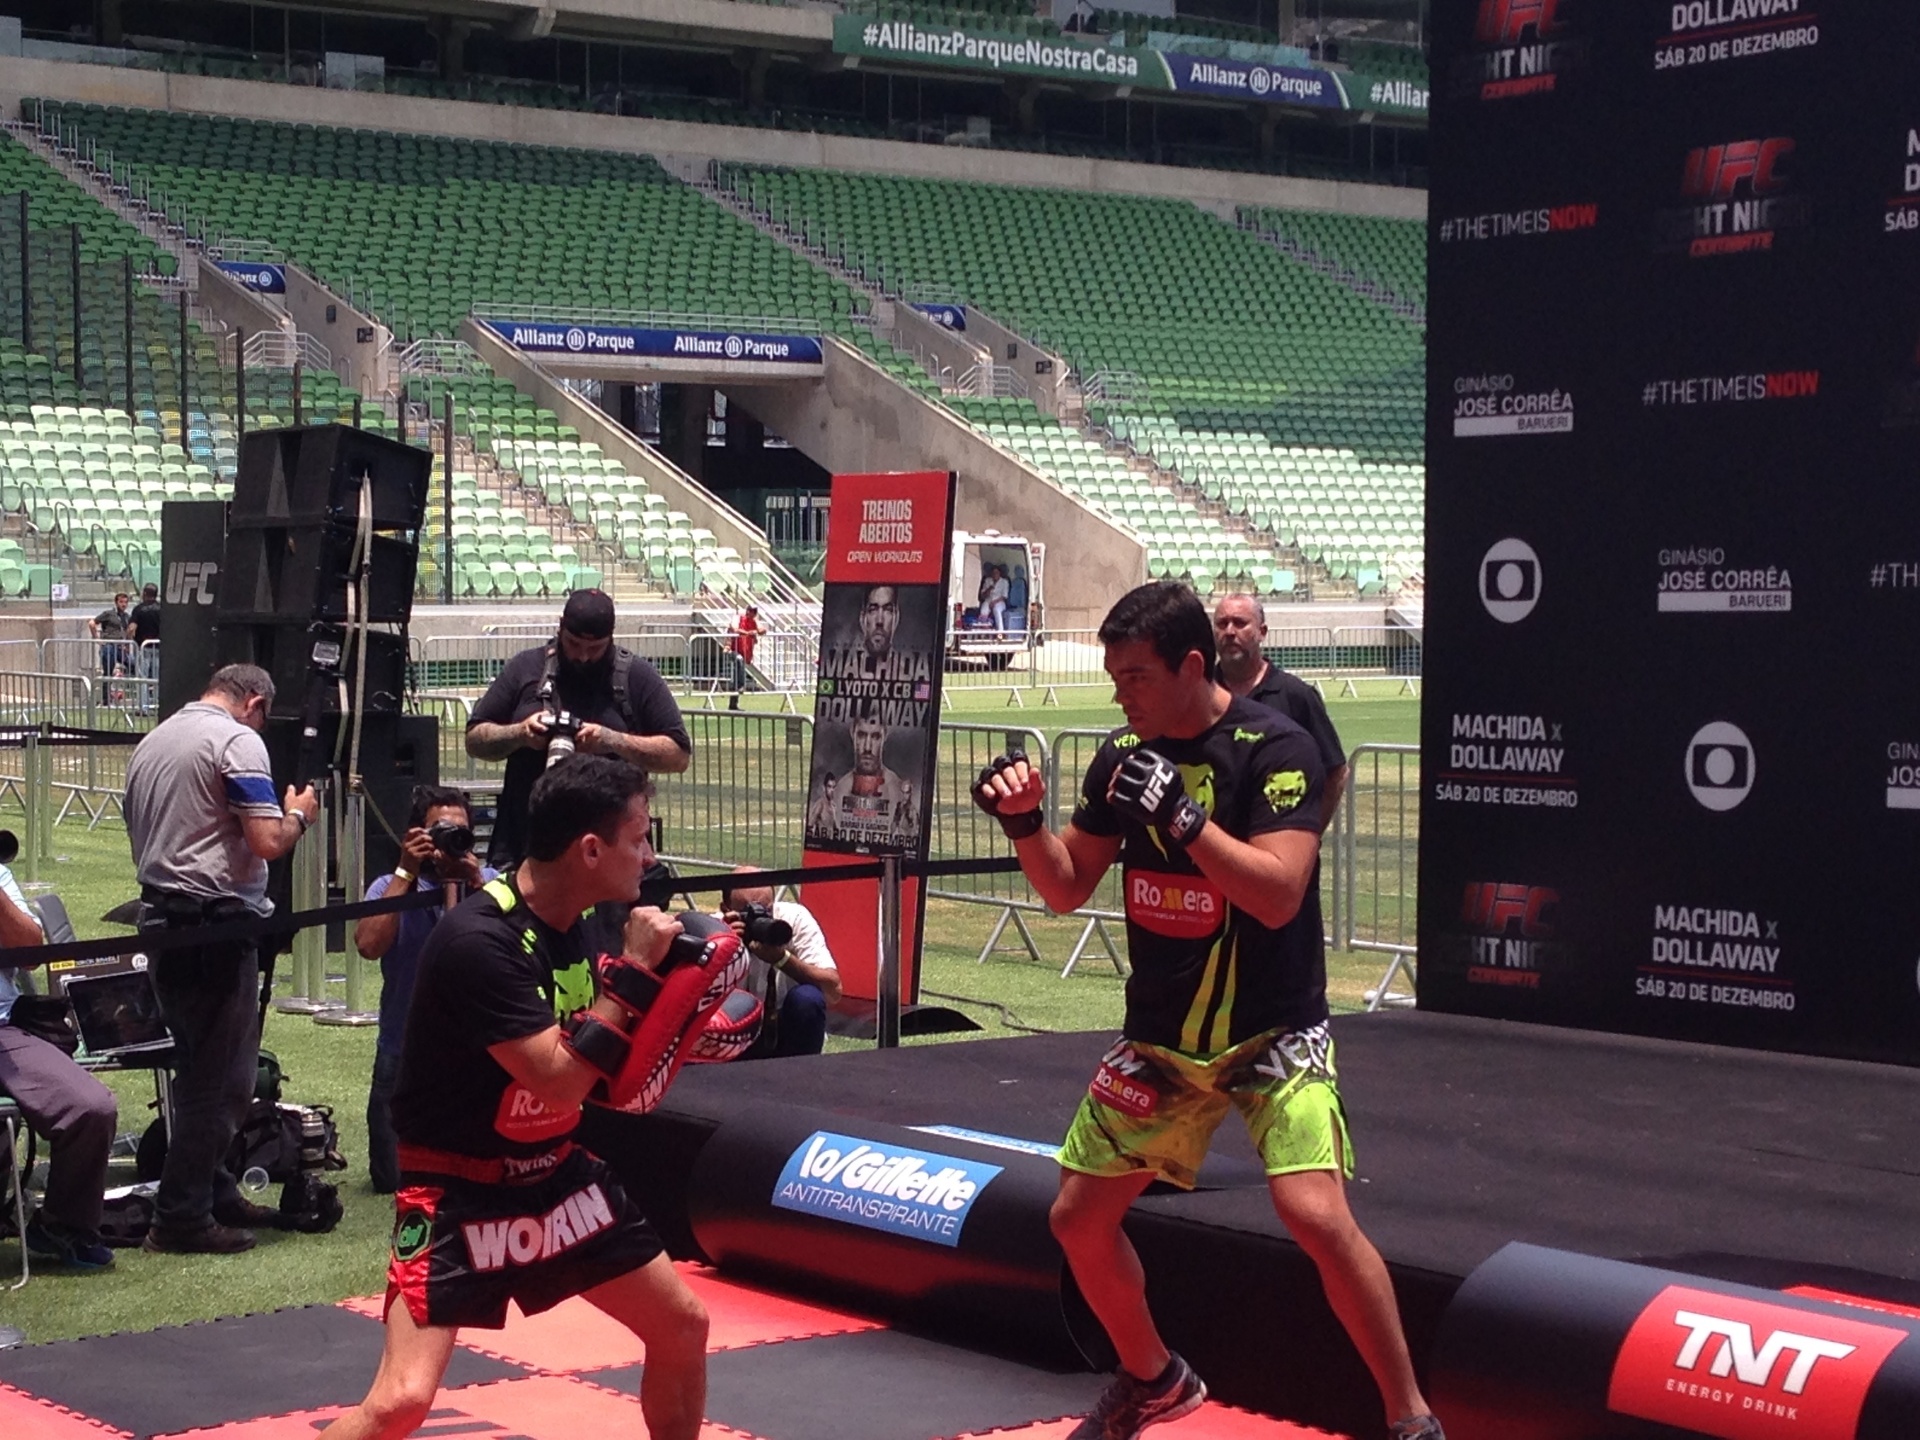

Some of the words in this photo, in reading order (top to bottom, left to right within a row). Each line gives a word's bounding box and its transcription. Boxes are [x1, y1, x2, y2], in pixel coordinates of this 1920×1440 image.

[863, 22, 1138, 77] #AllianzParqueNostraCasa
[1655, 46, 1685, 69] SÁB
[1688, 45, 1706, 64] 20
[1709, 41, 1729, 61] DE
[1732, 26, 1819, 57] DEZEMBRO
[1190, 63, 1247, 88] Allianz
[1272, 72, 1323, 98] Parque
[513, 328, 564, 347] Allianz
[587, 334, 634, 353] Parque
[674, 336, 722, 354] Allianz
[744, 342, 789, 360] Parque
[1454, 373, 1514, 394] GINÁSIO
[1454, 393, 1497, 416] JOSÉ
[1502, 388, 1574, 414] CORRÊA
[1518, 416, 1568, 431] BARUERI
[862, 500, 912, 521] TREINOS
[859, 522, 912, 543] ABERTOS
[847, 551, 872, 563] OPEN
[874, 551, 923, 563] WORKOUTS
[1659, 545, 1725, 566] GINÁSIO
[166, 562, 217, 604] UFC
[1658, 567, 1706, 590] JOSÉ
[1711, 565, 1792, 589] CORRÊA
[1729, 594, 1787, 608] BARUERI
[820, 650, 930, 681] MACHIDA
[837, 680, 878, 697] LYOTO
[881, 683, 891, 698] X
[893, 683, 911, 698] CB
[817, 697, 928, 727] DOLLAWAY
[1452, 714, 1546, 740] MACHIDA
[1451, 744, 1564, 772] DOLLAWAY
[1139, 762, 1173, 813] UFC
[1435, 781, 1462, 800] SÁB
[1465, 785, 1480, 802] 20
[1483, 786, 1500, 803] DE
[1503, 787, 1578, 807] DEZEMBRO
[1655, 905, 1760, 938] MACHIDA
[1652, 937, 1780, 972] DOLLAWAY
[1636, 976, 1666, 996] SÁB
[1668, 982, 1686, 998] 20
[1689, 983, 1708, 1001] DE
[1711, 986, 1795, 1011] DEZEMBRO
[780, 1181, 959, 1235] ANTITRANSPIRANTE
[1674, 1310, 1857, 1394] TNT
[1666, 1378, 1734, 1403] ENERGY
[1743, 1397, 1798, 1420] DRINK
